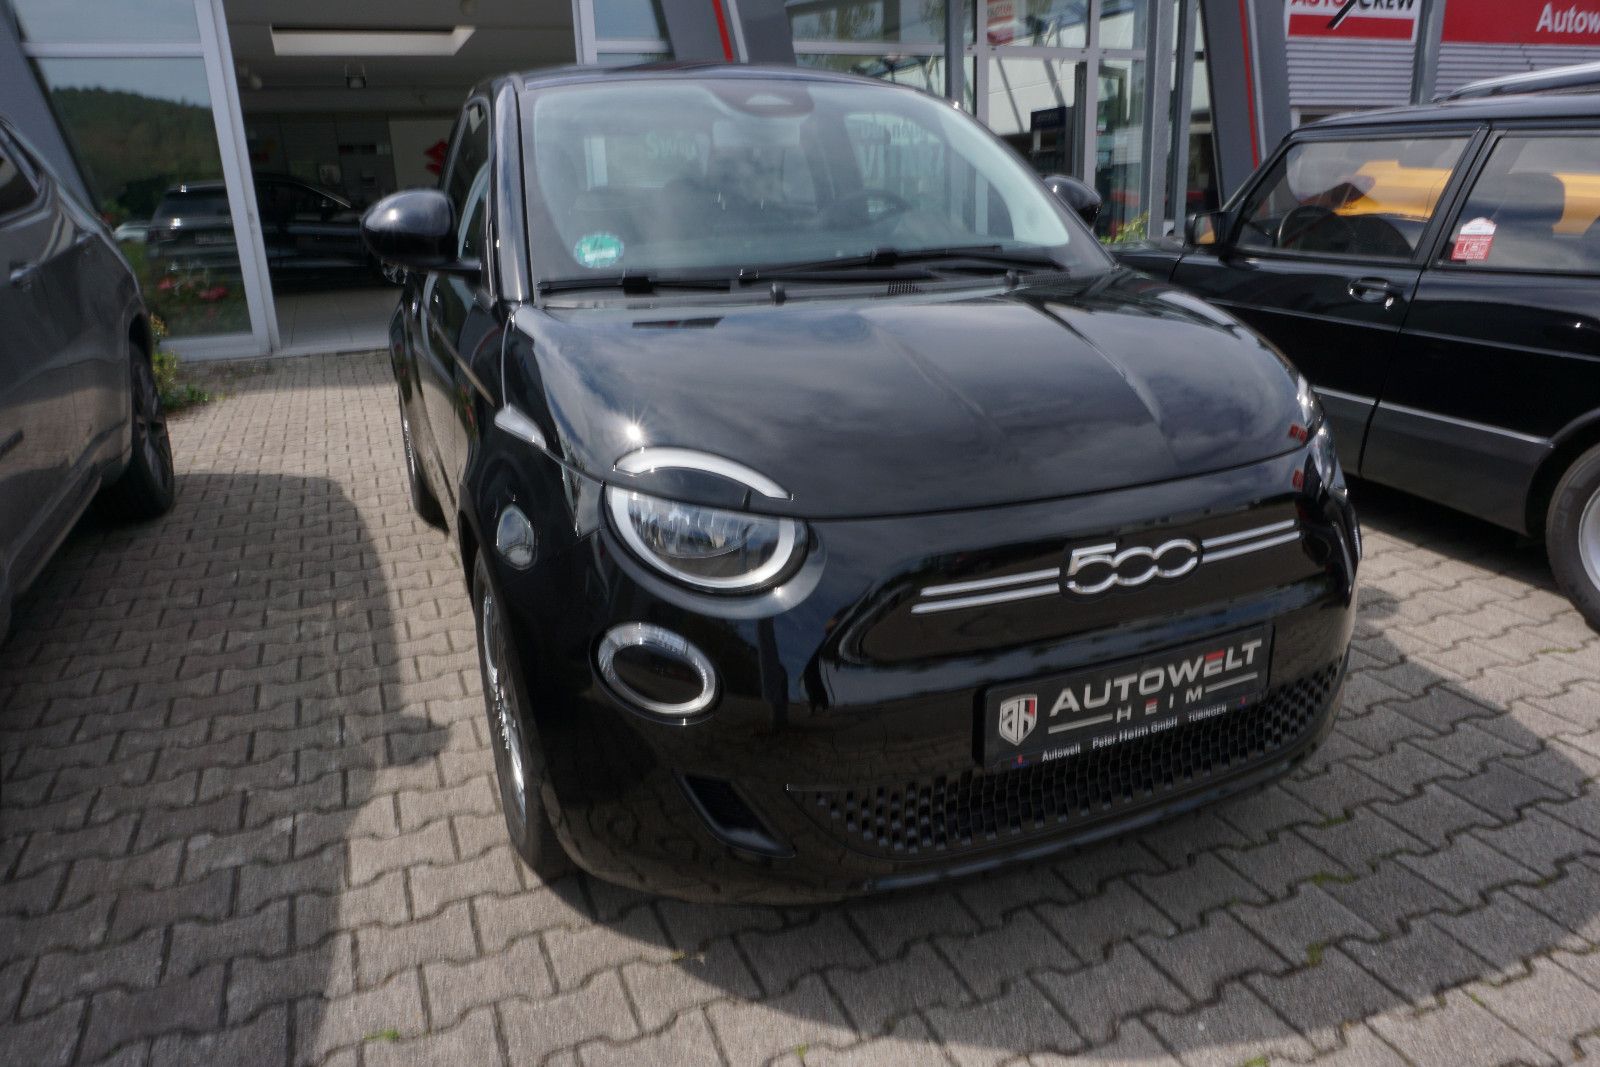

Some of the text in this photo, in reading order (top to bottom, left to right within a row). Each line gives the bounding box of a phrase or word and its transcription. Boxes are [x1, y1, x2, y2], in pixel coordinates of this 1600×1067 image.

[1067, 538, 1198, 594] 500
[1050, 638, 1262, 717] AUTOWELT
[1116, 686, 1203, 723] HEIM
[1119, 725, 1149, 743] Heim
[1151, 715, 1178, 733] GmbH
